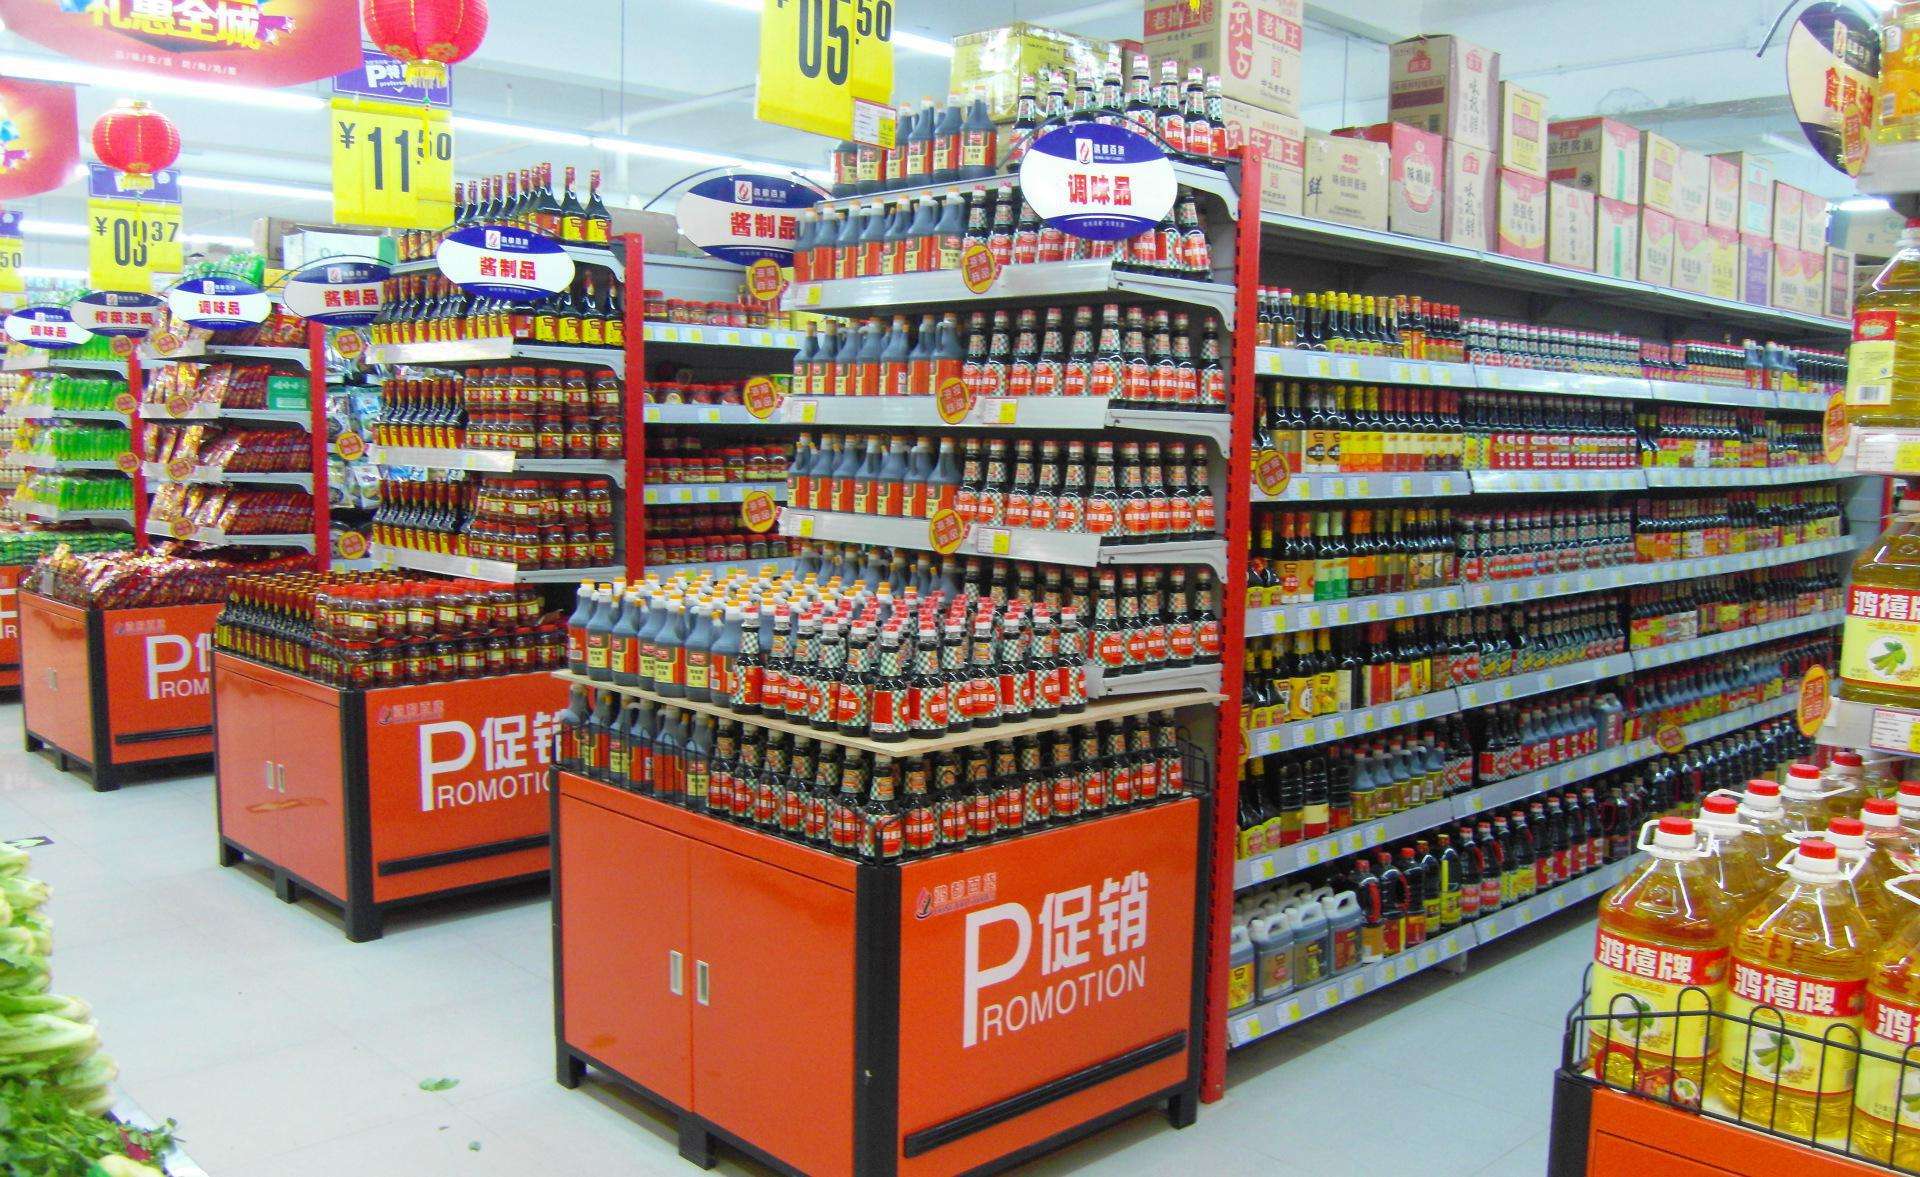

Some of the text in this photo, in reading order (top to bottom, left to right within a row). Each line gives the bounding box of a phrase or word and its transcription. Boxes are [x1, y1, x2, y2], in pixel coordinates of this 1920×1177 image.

[1068, 174, 1132, 206] 调味品
[730, 211, 797, 240] 酱制品
[480, 256, 536, 280] 酱制品
[198, 300, 241, 316] 调味品
[324, 289, 379, 306] 酱制品
[31, 325, 67, 338] 调味品
[1039, 870, 1149, 976] 促销
[1600, 933, 1692, 983] 鸿禧牌
[1735, 963, 1836, 1014] 鸿禧牌
[1876, 1003, 1920, 1044] 鸿
